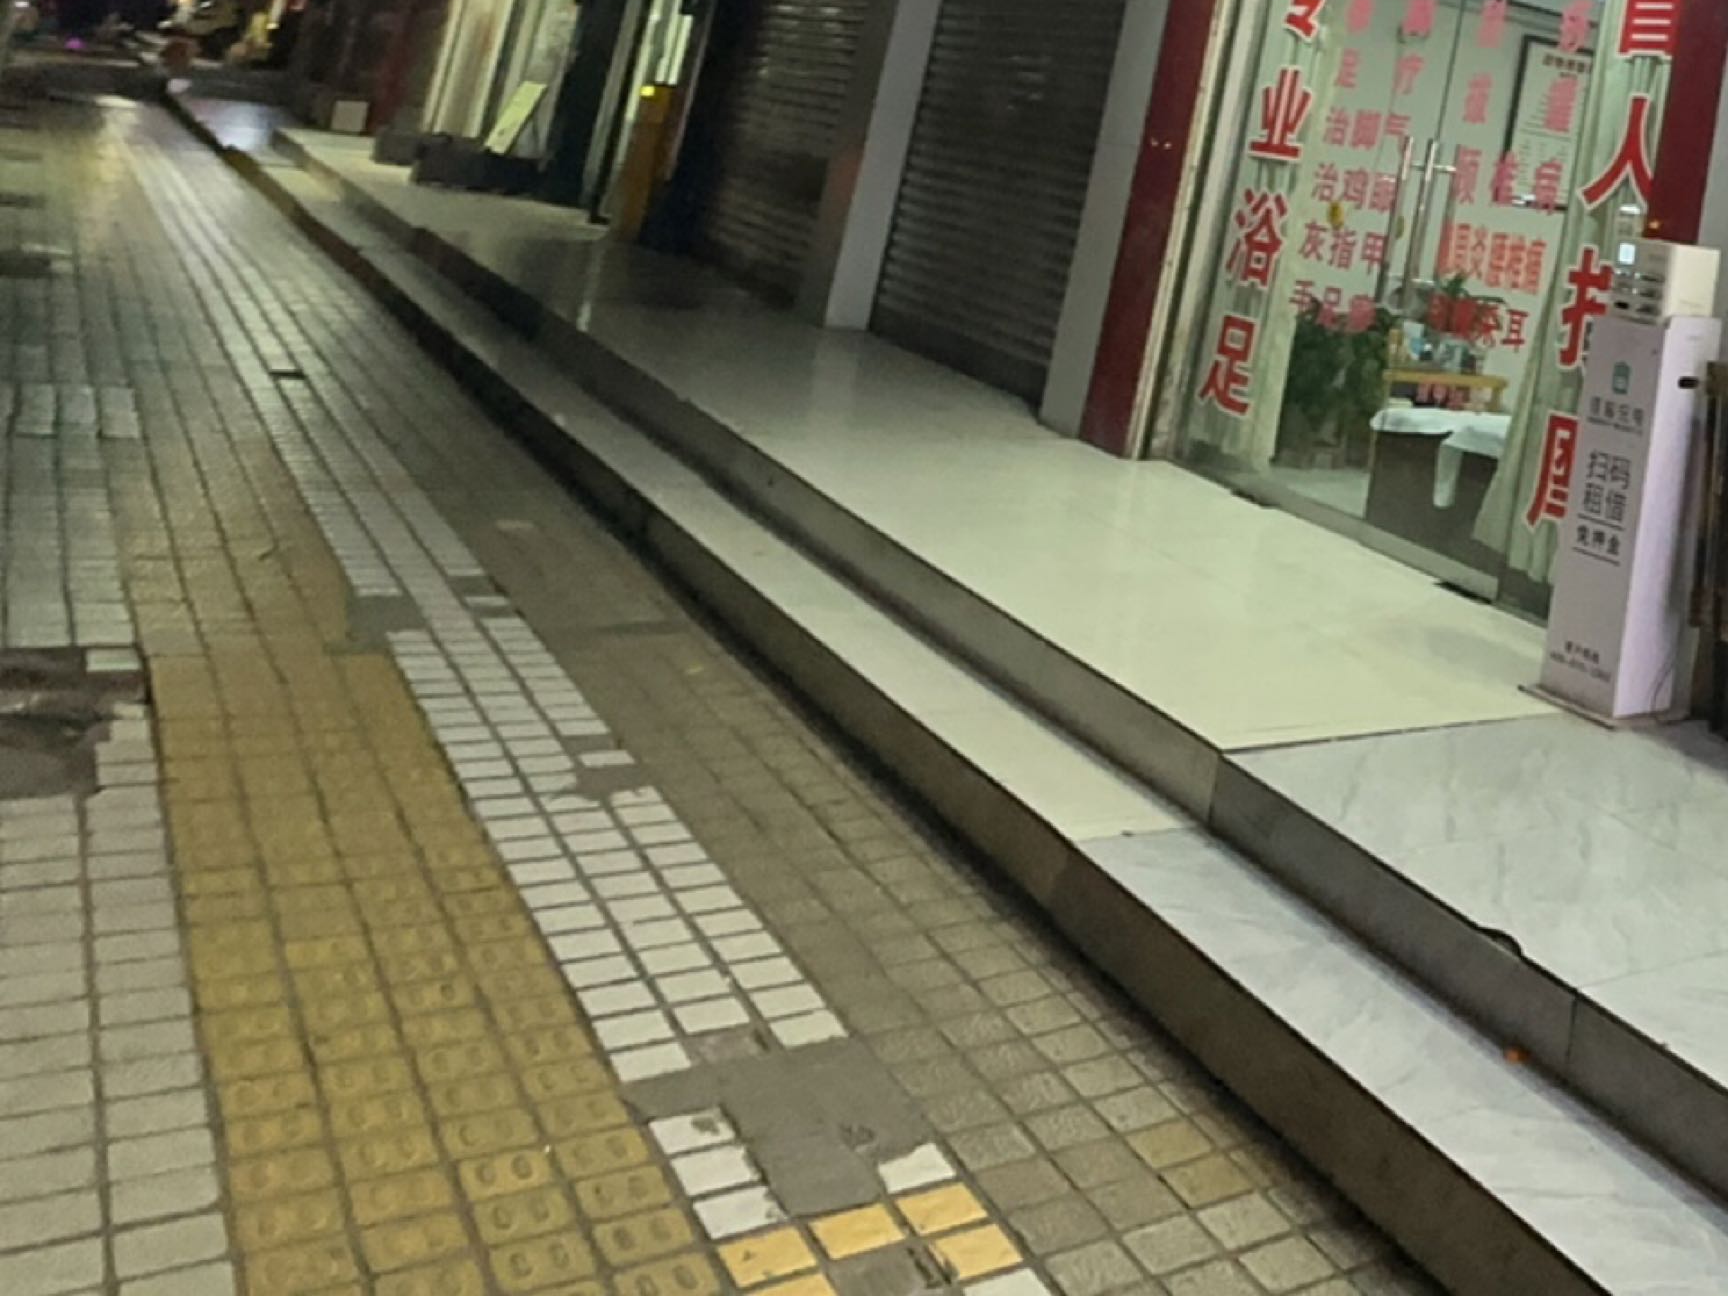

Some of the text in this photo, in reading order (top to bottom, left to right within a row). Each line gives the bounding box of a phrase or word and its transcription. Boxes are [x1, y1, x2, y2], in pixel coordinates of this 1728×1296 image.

[1298, 220, 1387, 275] 灰指甲
[1587, 449, 1631, 490] 扫码
